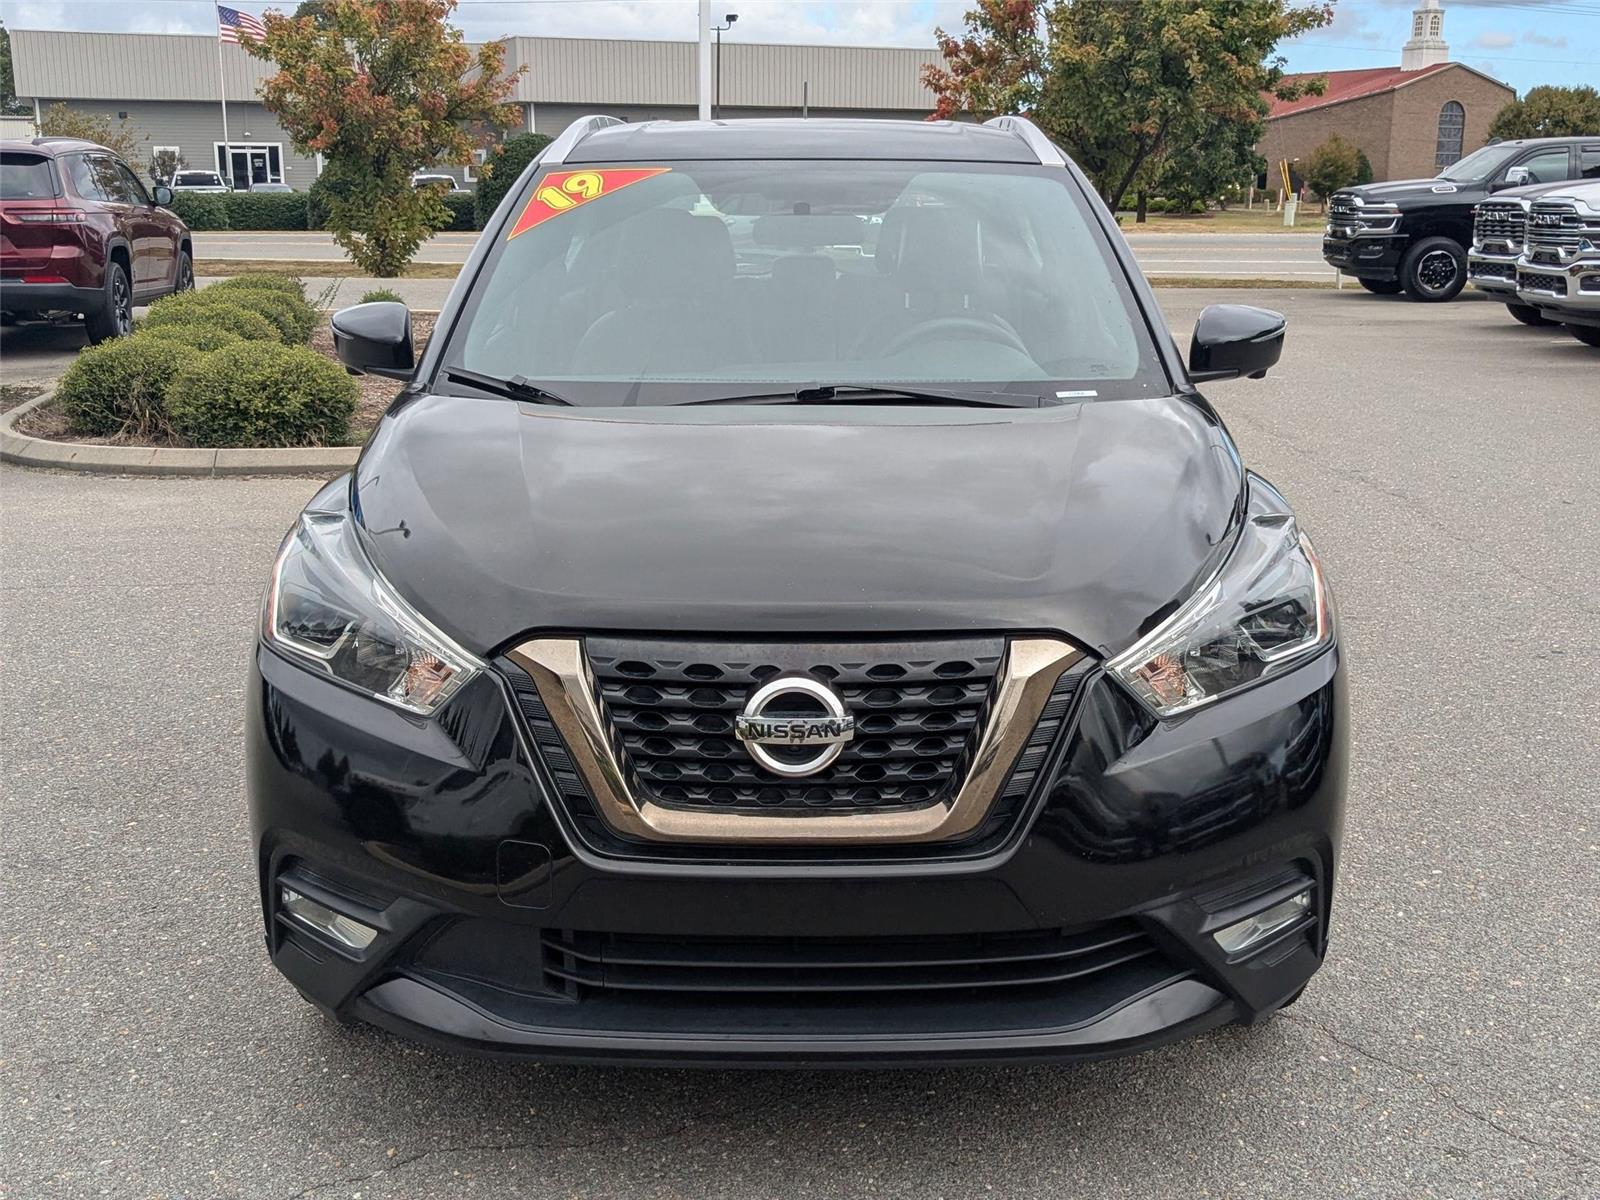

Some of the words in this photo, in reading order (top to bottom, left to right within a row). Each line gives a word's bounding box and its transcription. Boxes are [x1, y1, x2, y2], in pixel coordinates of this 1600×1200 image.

[537, 171, 604, 210] 19
[1534, 214, 1560, 225] RAM
[748, 723, 841, 739] NISSAN
